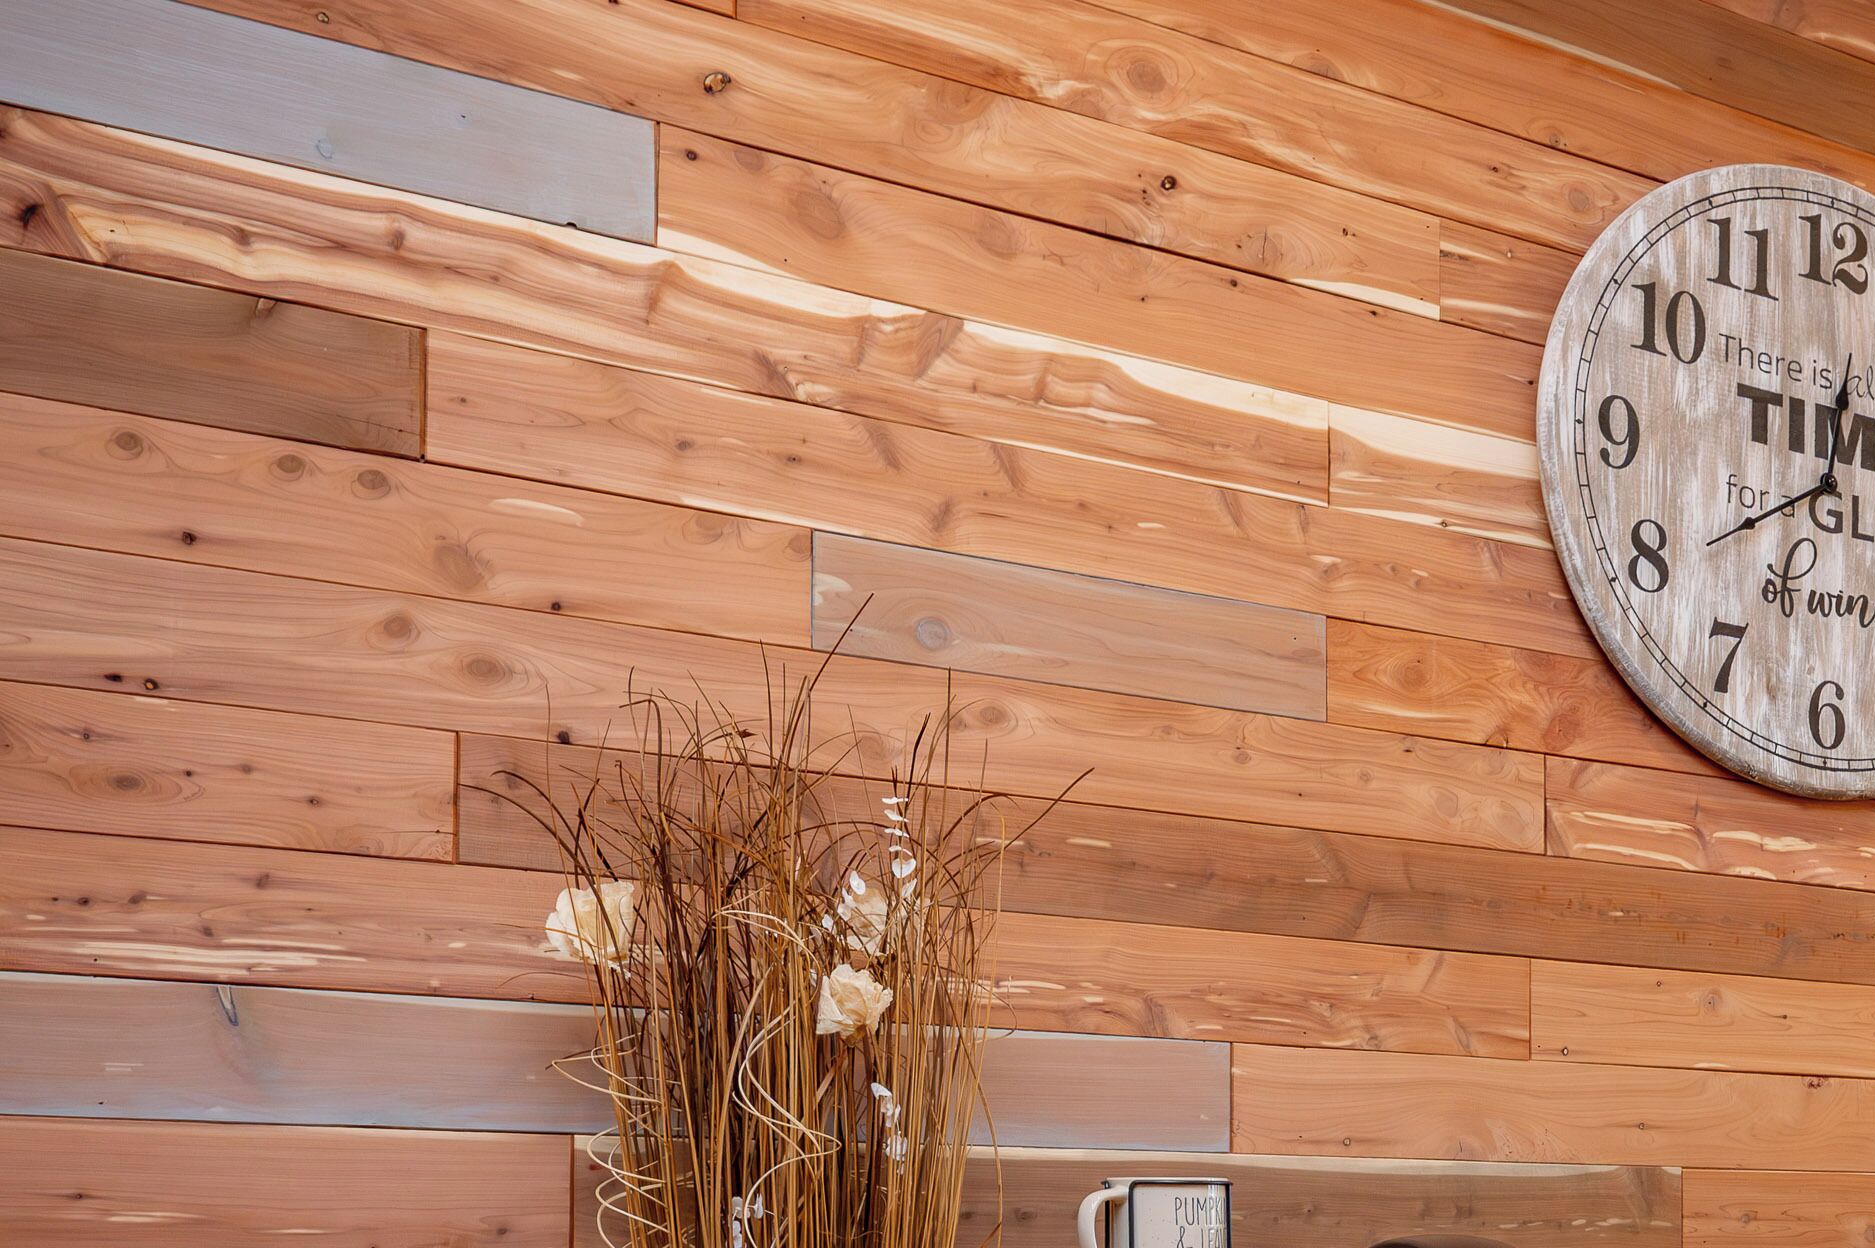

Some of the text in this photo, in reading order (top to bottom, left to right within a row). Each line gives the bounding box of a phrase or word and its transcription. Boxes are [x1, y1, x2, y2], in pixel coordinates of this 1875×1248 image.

[1706, 216, 1779, 302] 11
[1799, 215, 1869, 295] 12
[1630, 281, 1706, 365] 10
[1719, 333, 1802, 382] There
[1813, 360, 1833, 389] is
[1599, 395, 1640, 469] 9
[1726, 474, 1770, 511] for
[1780, 495, 1796, 518] a
[1628, 519, 1669, 593] 8
[1762, 537, 1818, 618] of
[1708, 616, 1749, 693] 7
[1808, 681, 1844, 750] 6
